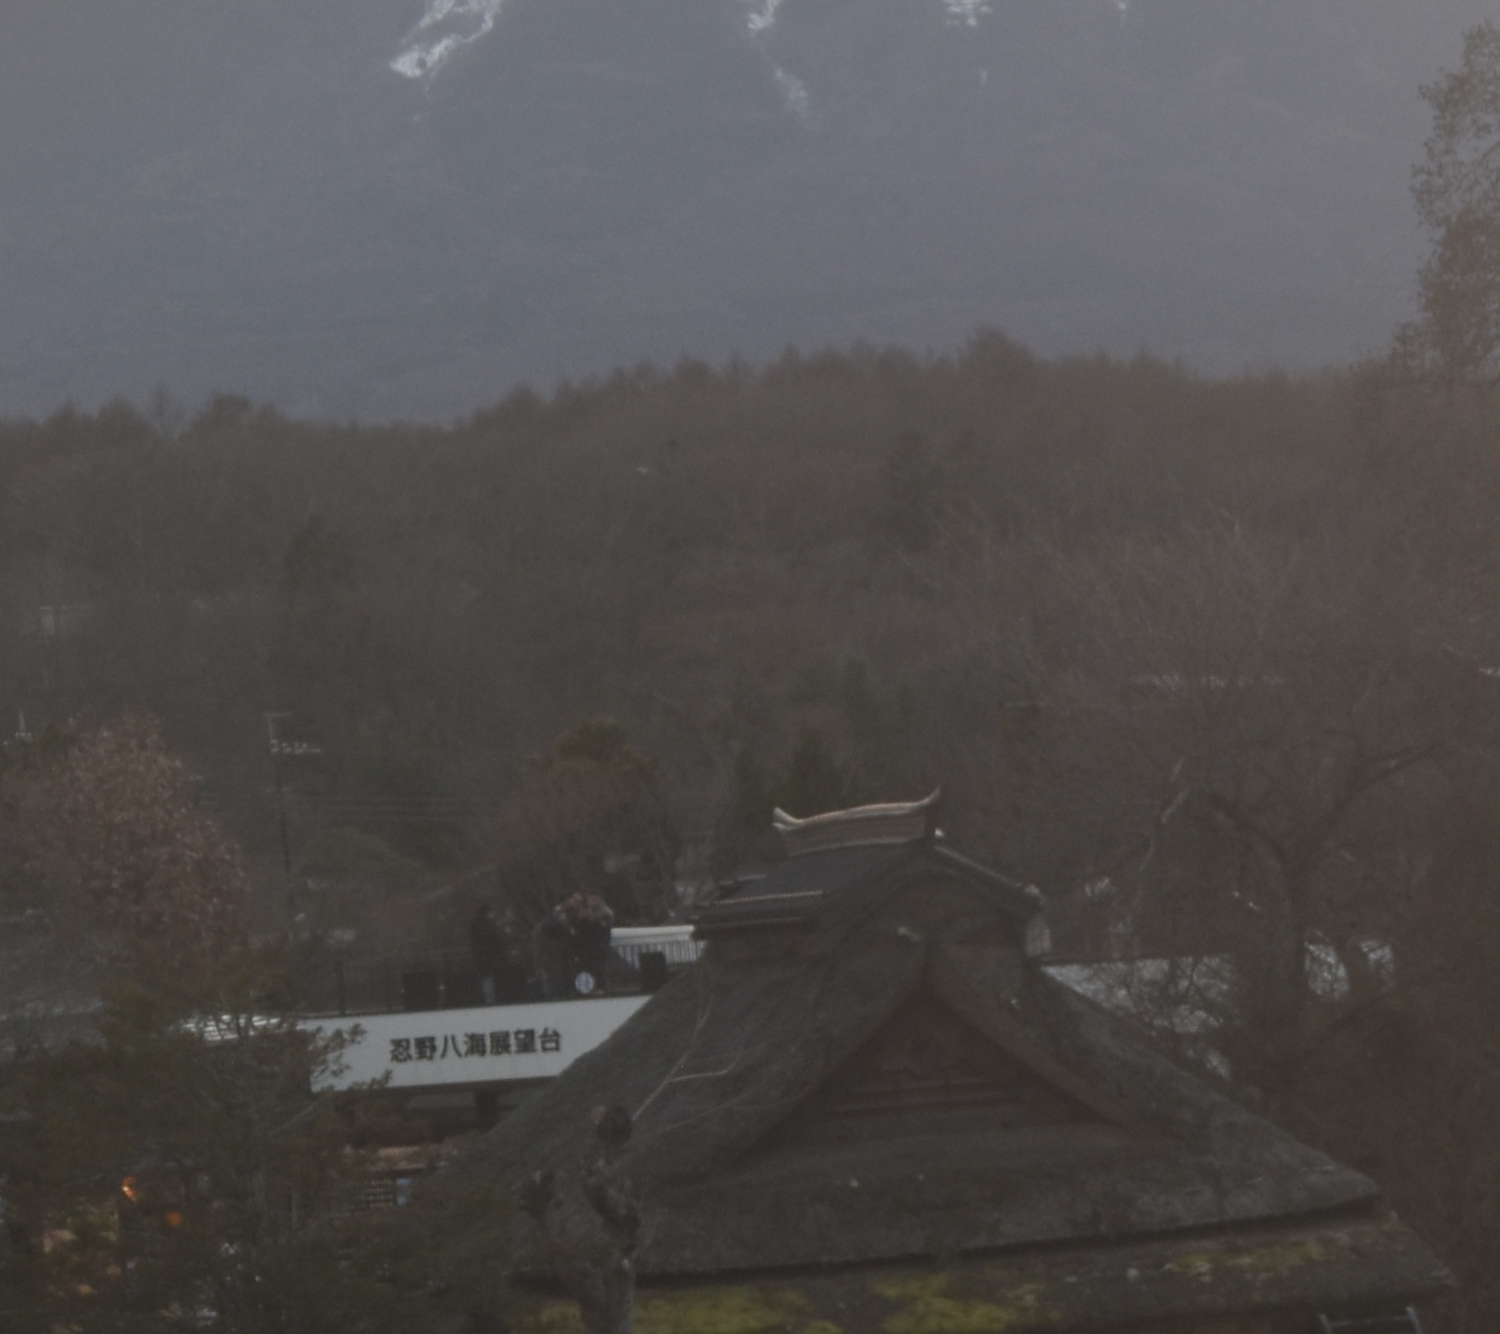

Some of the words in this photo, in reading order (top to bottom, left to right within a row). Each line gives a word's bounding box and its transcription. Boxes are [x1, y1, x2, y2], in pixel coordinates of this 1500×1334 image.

[390, 1027, 561, 1062] 忍野八海展望台
